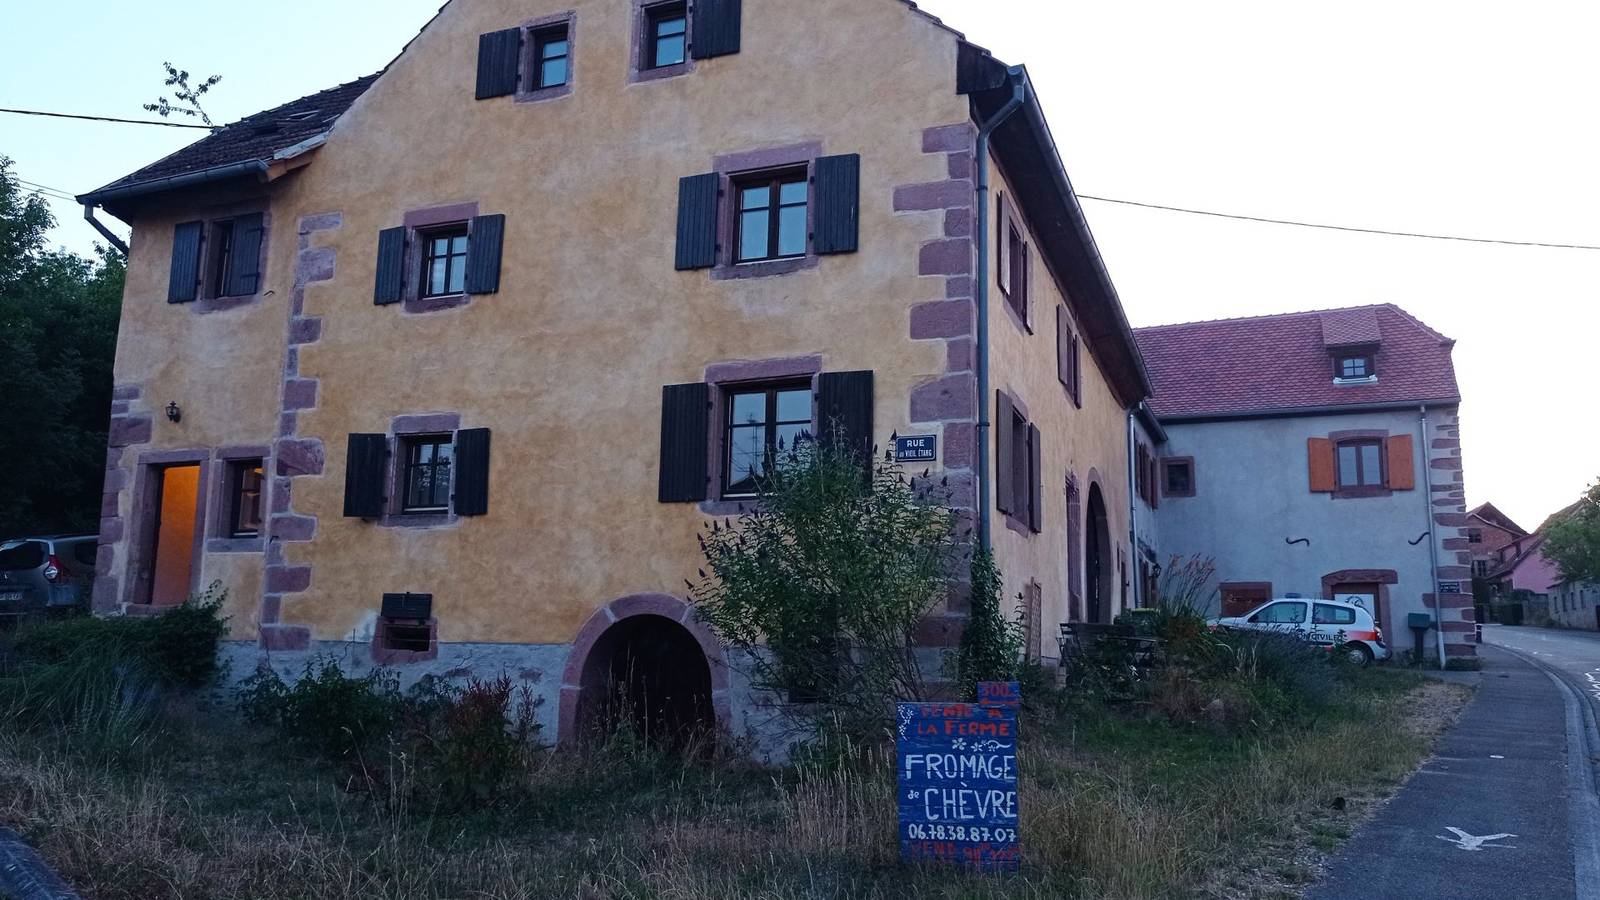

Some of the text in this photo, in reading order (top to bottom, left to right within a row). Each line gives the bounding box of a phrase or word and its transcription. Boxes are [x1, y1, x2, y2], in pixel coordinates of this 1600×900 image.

[906, 439, 925, 448] RUE
[917, 720, 938, 735] LA
[905, 753, 1017, 780] FROMAGE
[907, 781, 1017, 820] de CHÈVRE
[908, 823, 1017, 842] 06.78.38.87.07
